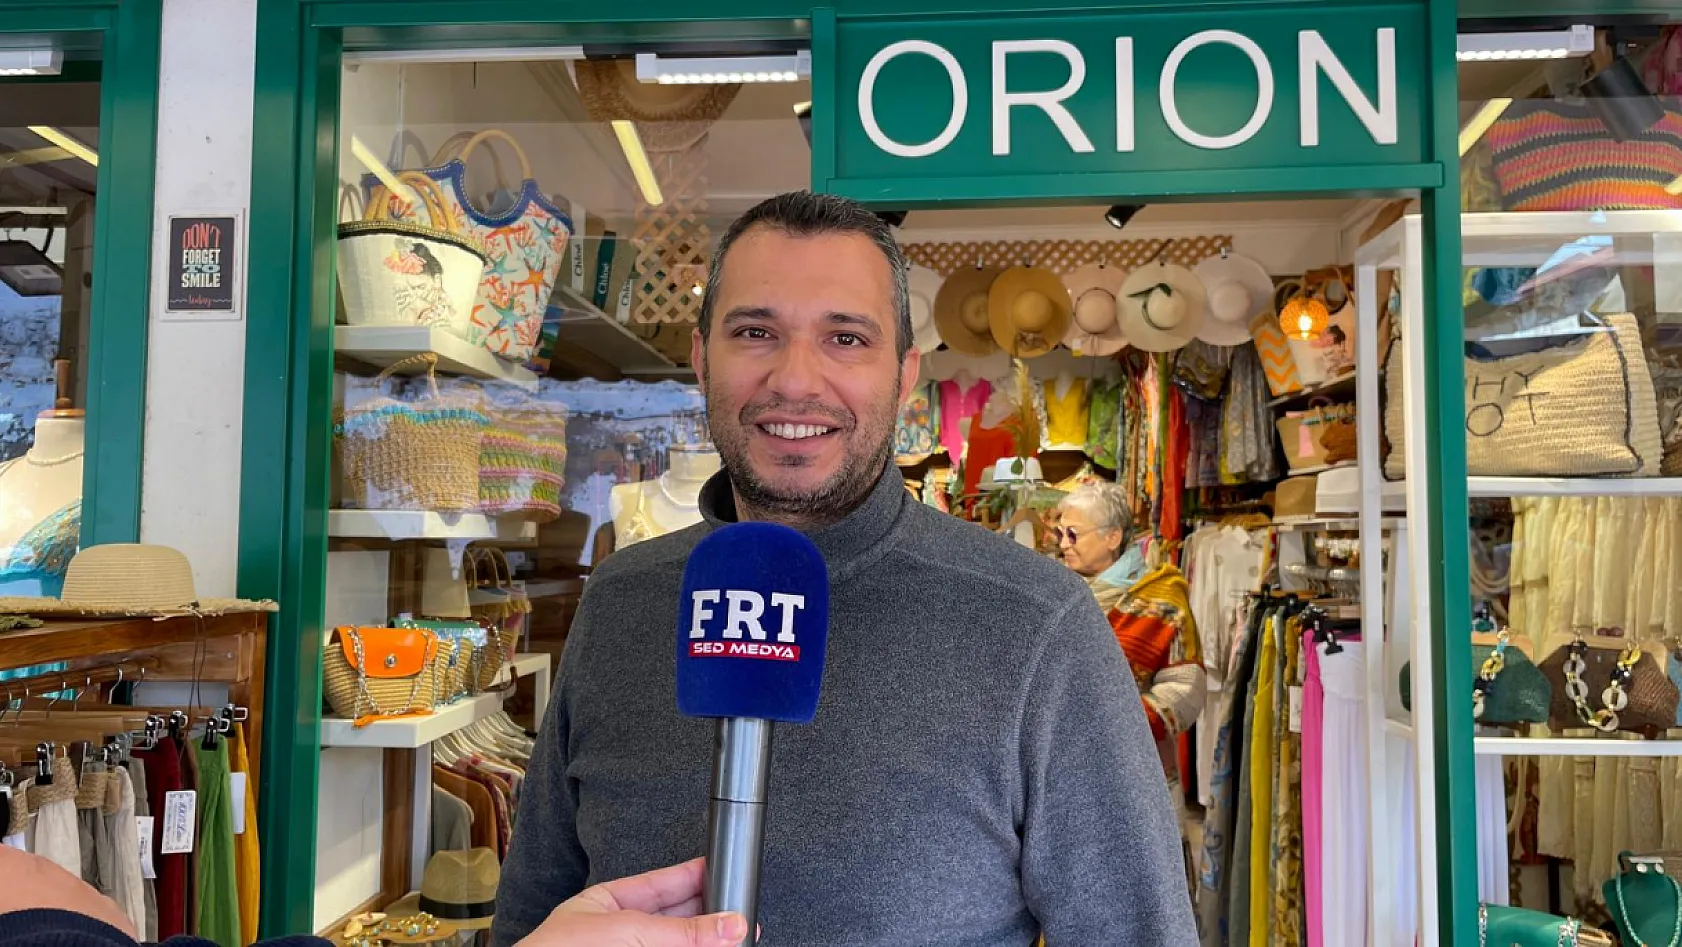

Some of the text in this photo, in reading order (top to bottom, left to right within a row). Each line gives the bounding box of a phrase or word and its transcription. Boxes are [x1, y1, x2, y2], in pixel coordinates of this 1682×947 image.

[858, 27, 1398, 157] ORION
[182, 222, 221, 249] DON'T
[183, 249, 221, 265] FORGET
[182, 265, 220, 273] TO
[181, 272, 221, 288] SMILE
[1465, 365, 1545, 401] HY
[688, 588, 805, 643] FRT
[693, 642, 795, 658] SED MEDYA
